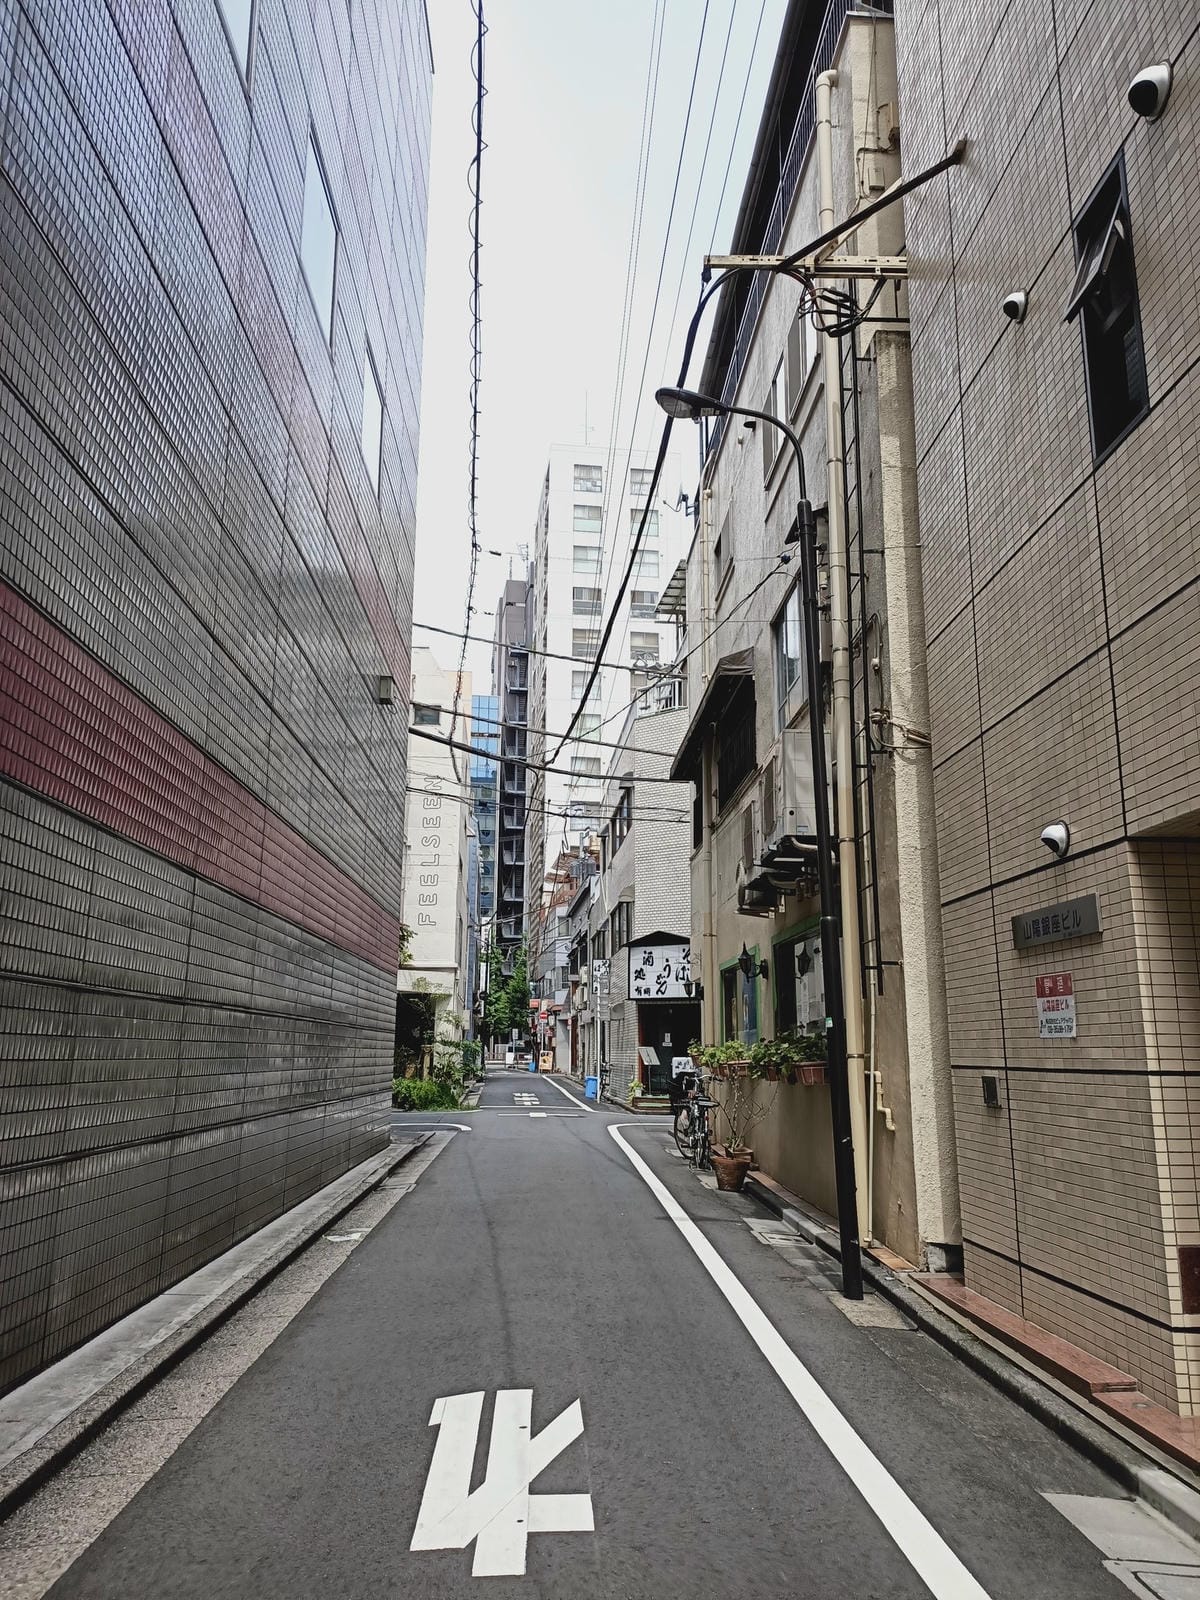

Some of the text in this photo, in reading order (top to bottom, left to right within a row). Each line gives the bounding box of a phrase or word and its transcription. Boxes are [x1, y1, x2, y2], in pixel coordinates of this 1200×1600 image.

[1023, 909, 1082, 940] 山陽銀座ビル
